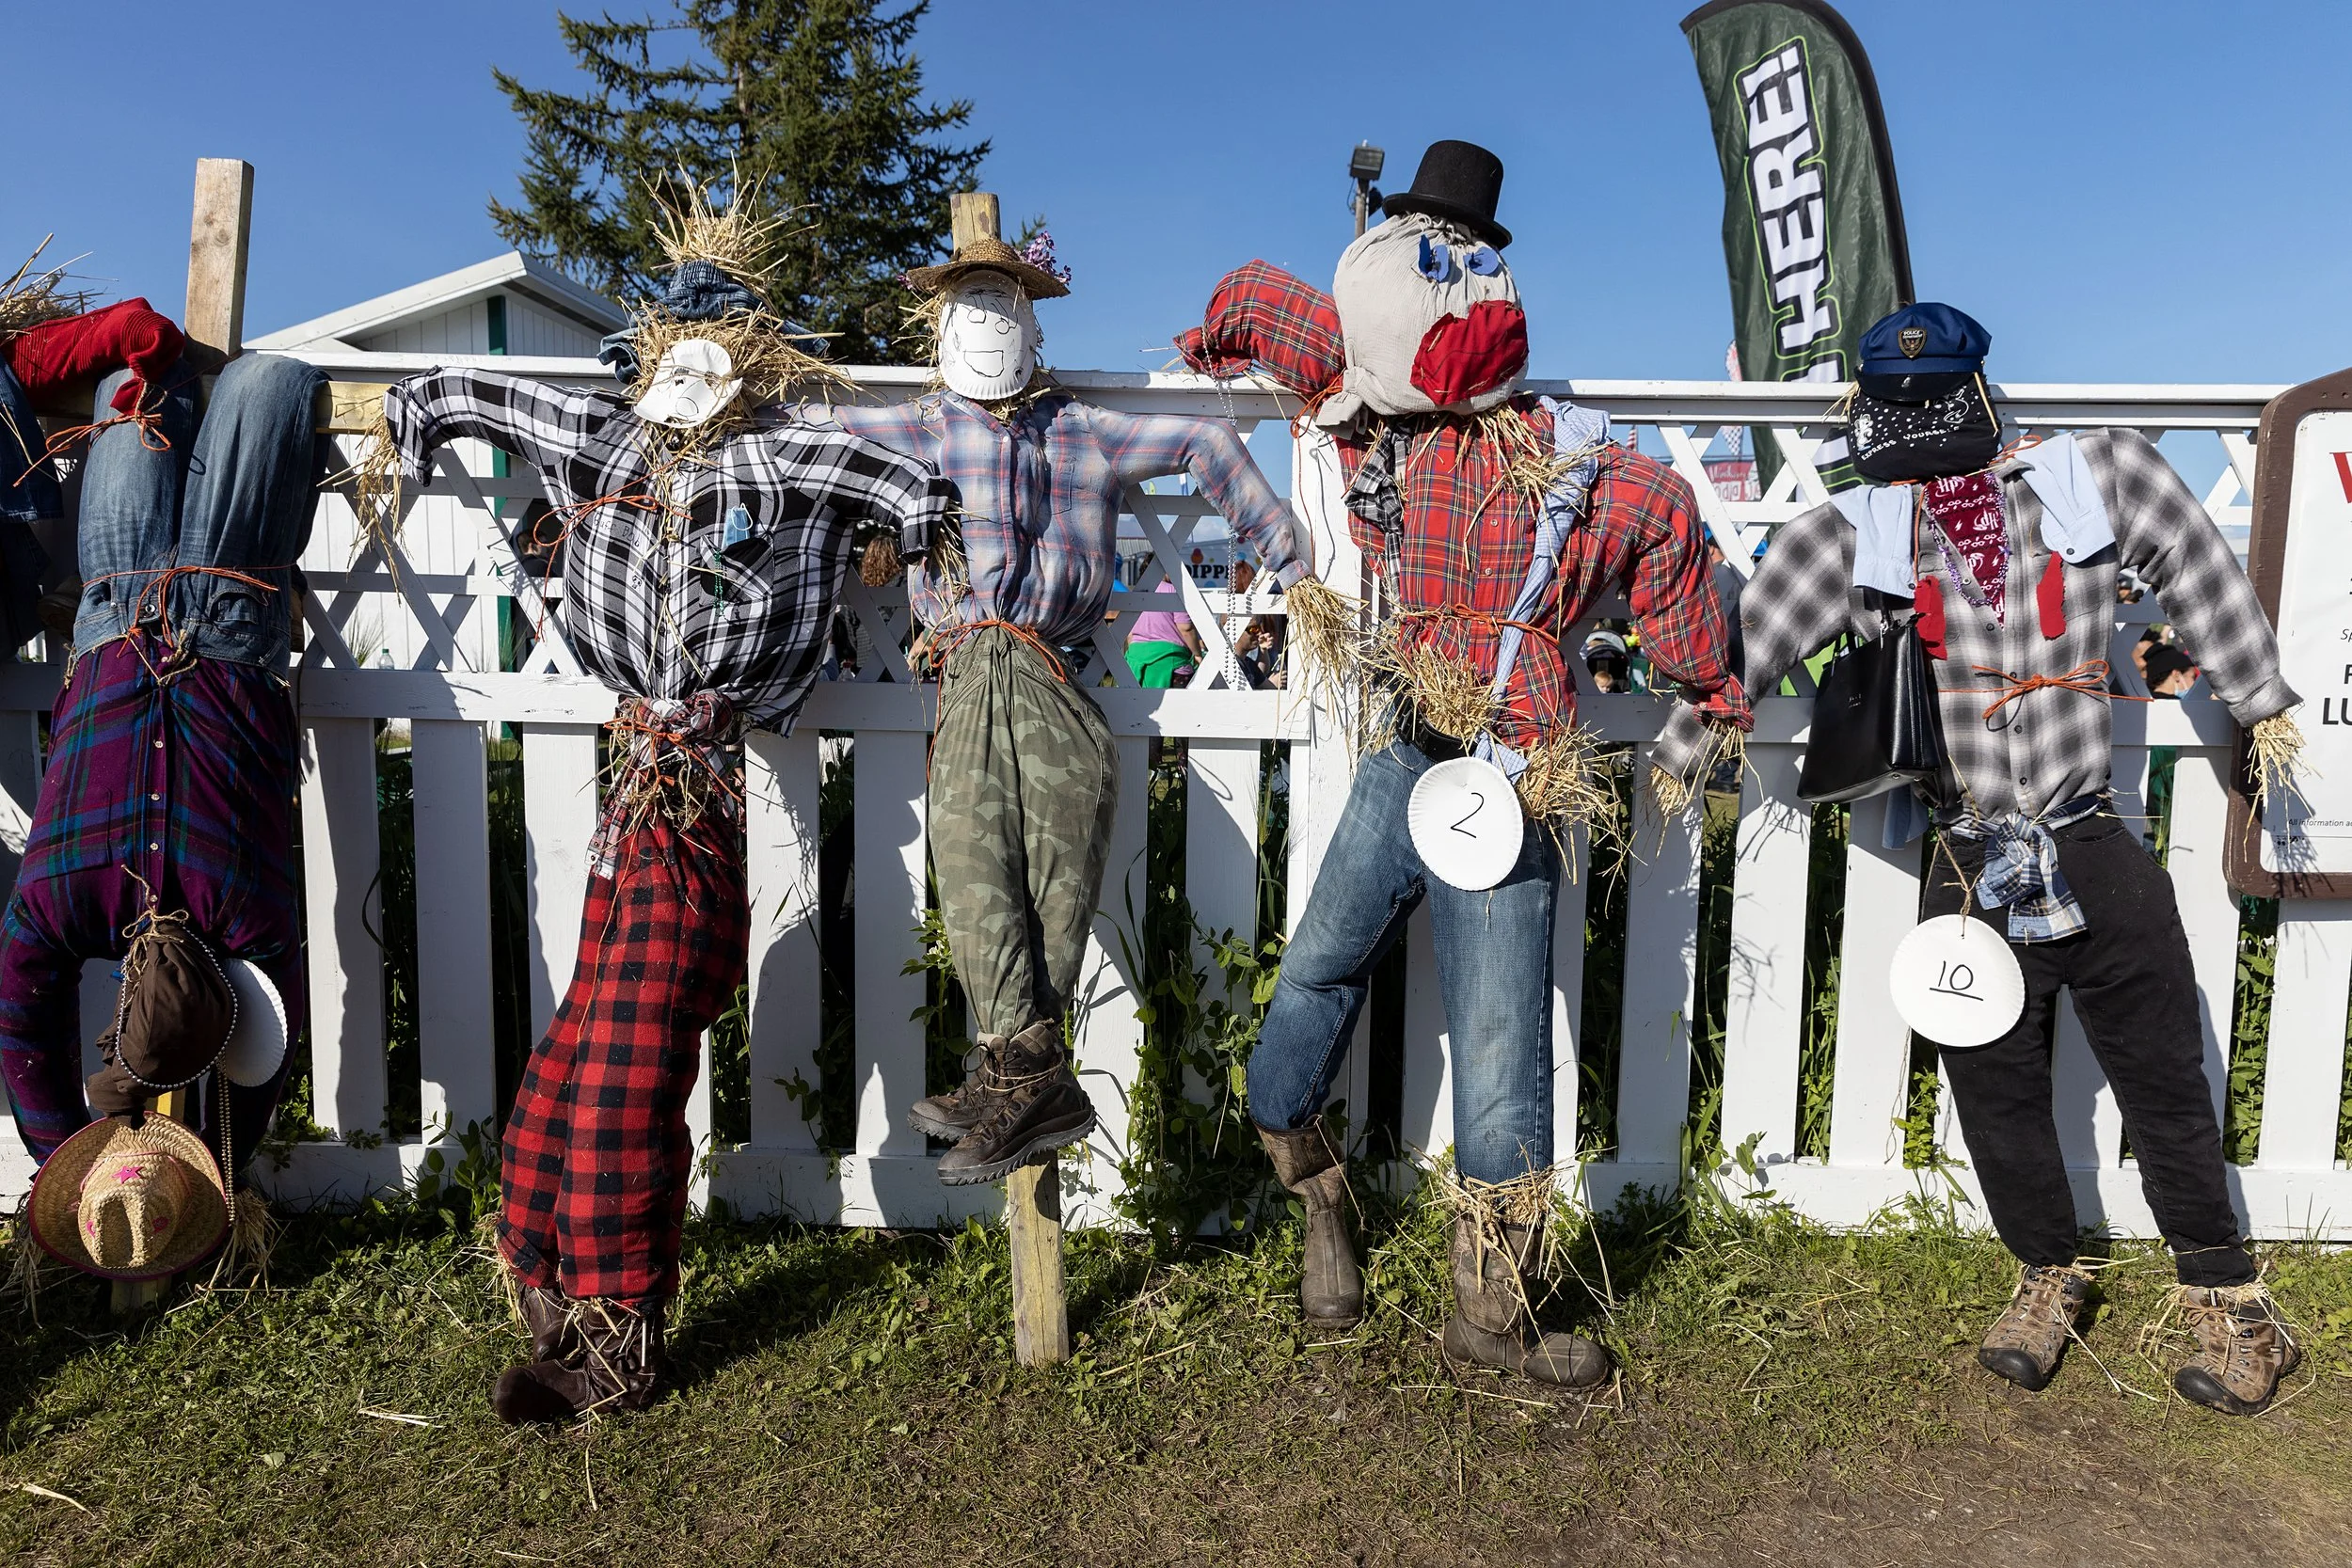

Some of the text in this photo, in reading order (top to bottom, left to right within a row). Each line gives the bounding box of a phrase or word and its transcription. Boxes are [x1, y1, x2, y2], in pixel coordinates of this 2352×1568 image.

[1742, 46, 1832, 349] HERE!
[1861, 439, 1897, 461] EXPRESS
[1450, 792, 1485, 839] 2
[2299, 818, 2344, 827] information
[1937, 960, 1974, 990] 10
